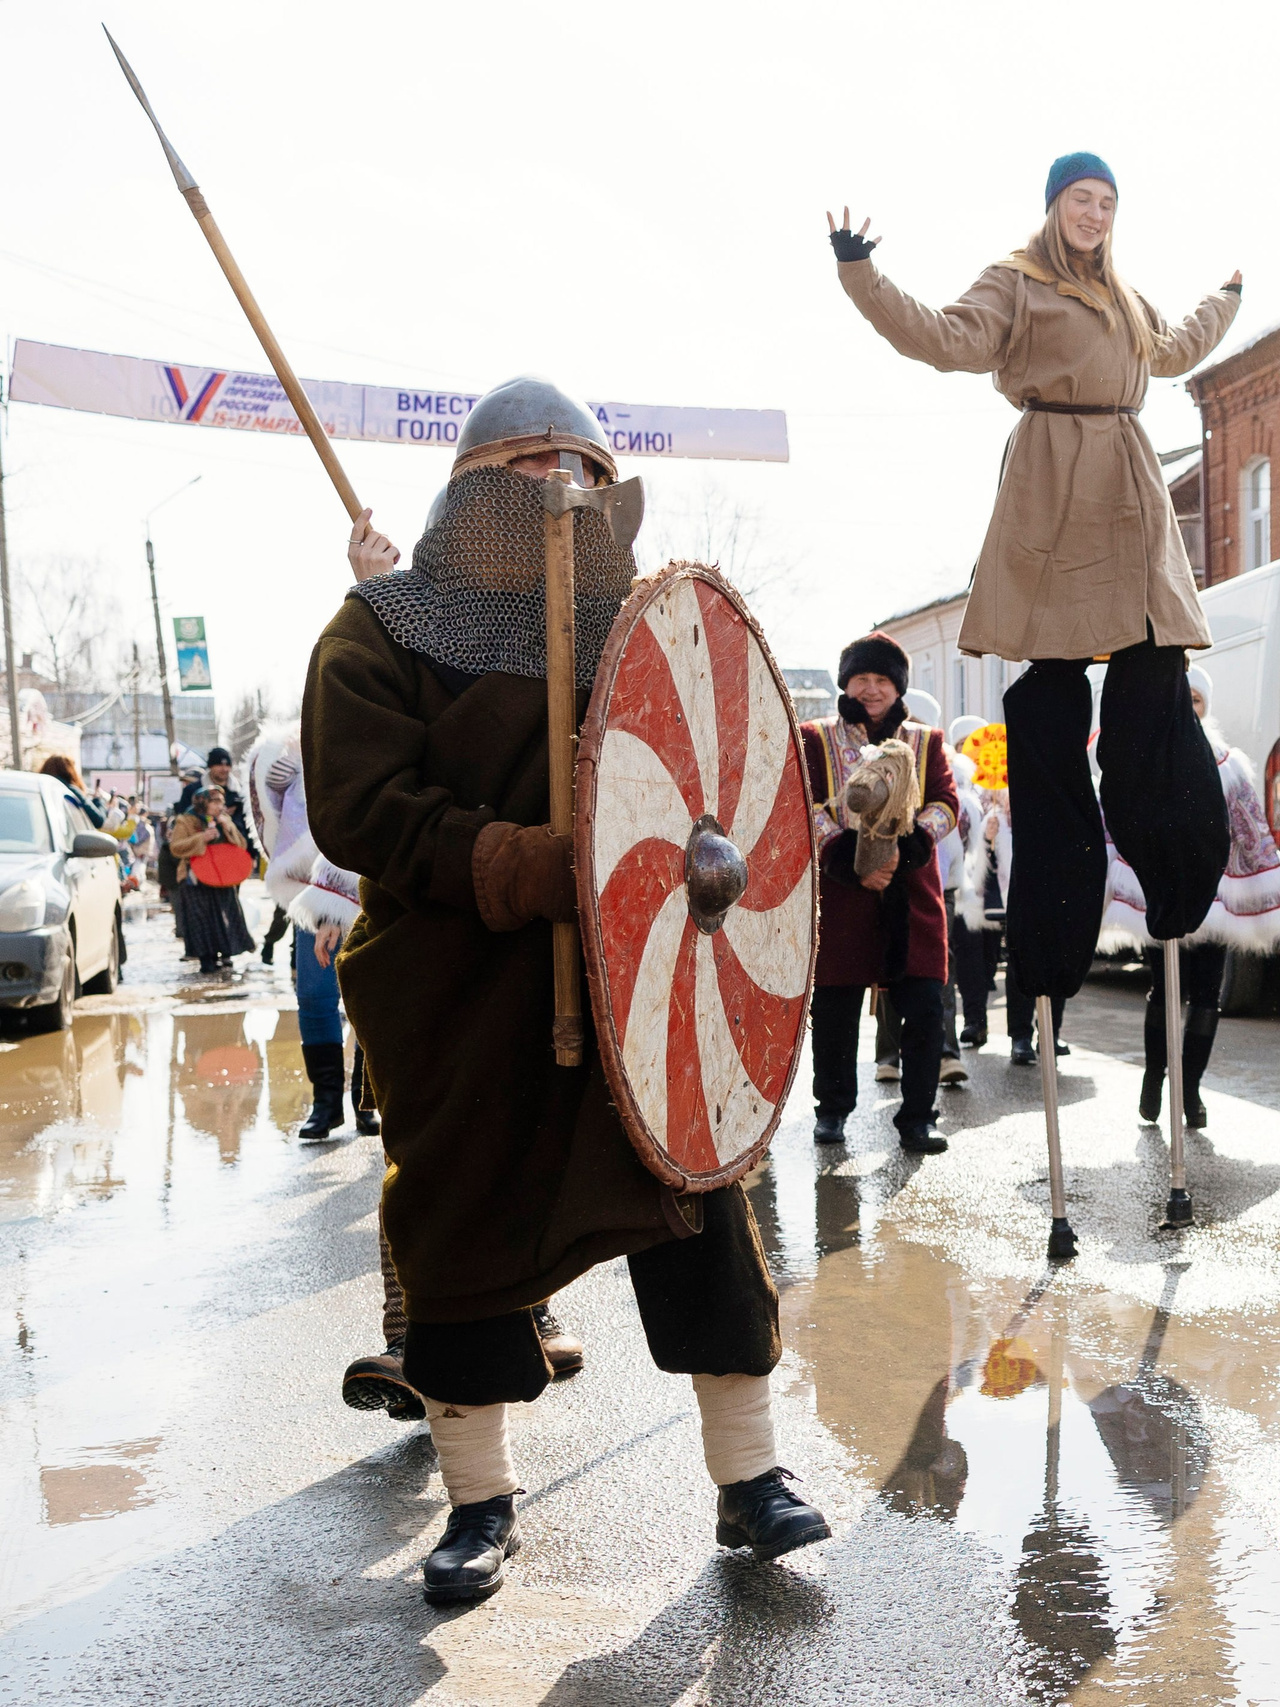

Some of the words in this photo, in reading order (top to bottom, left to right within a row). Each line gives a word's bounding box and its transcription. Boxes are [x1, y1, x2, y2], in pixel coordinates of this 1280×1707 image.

[232, 374, 282, 389] ВЫБОР
[216, 399, 270, 413] РОССИИ
[397, 392, 477, 416] ВМЕСТ
[251, 416, 300, 433] МАРТА
[397, 418, 459, 442] ГОЛО
[604, 430, 672, 453] СИЮ!
